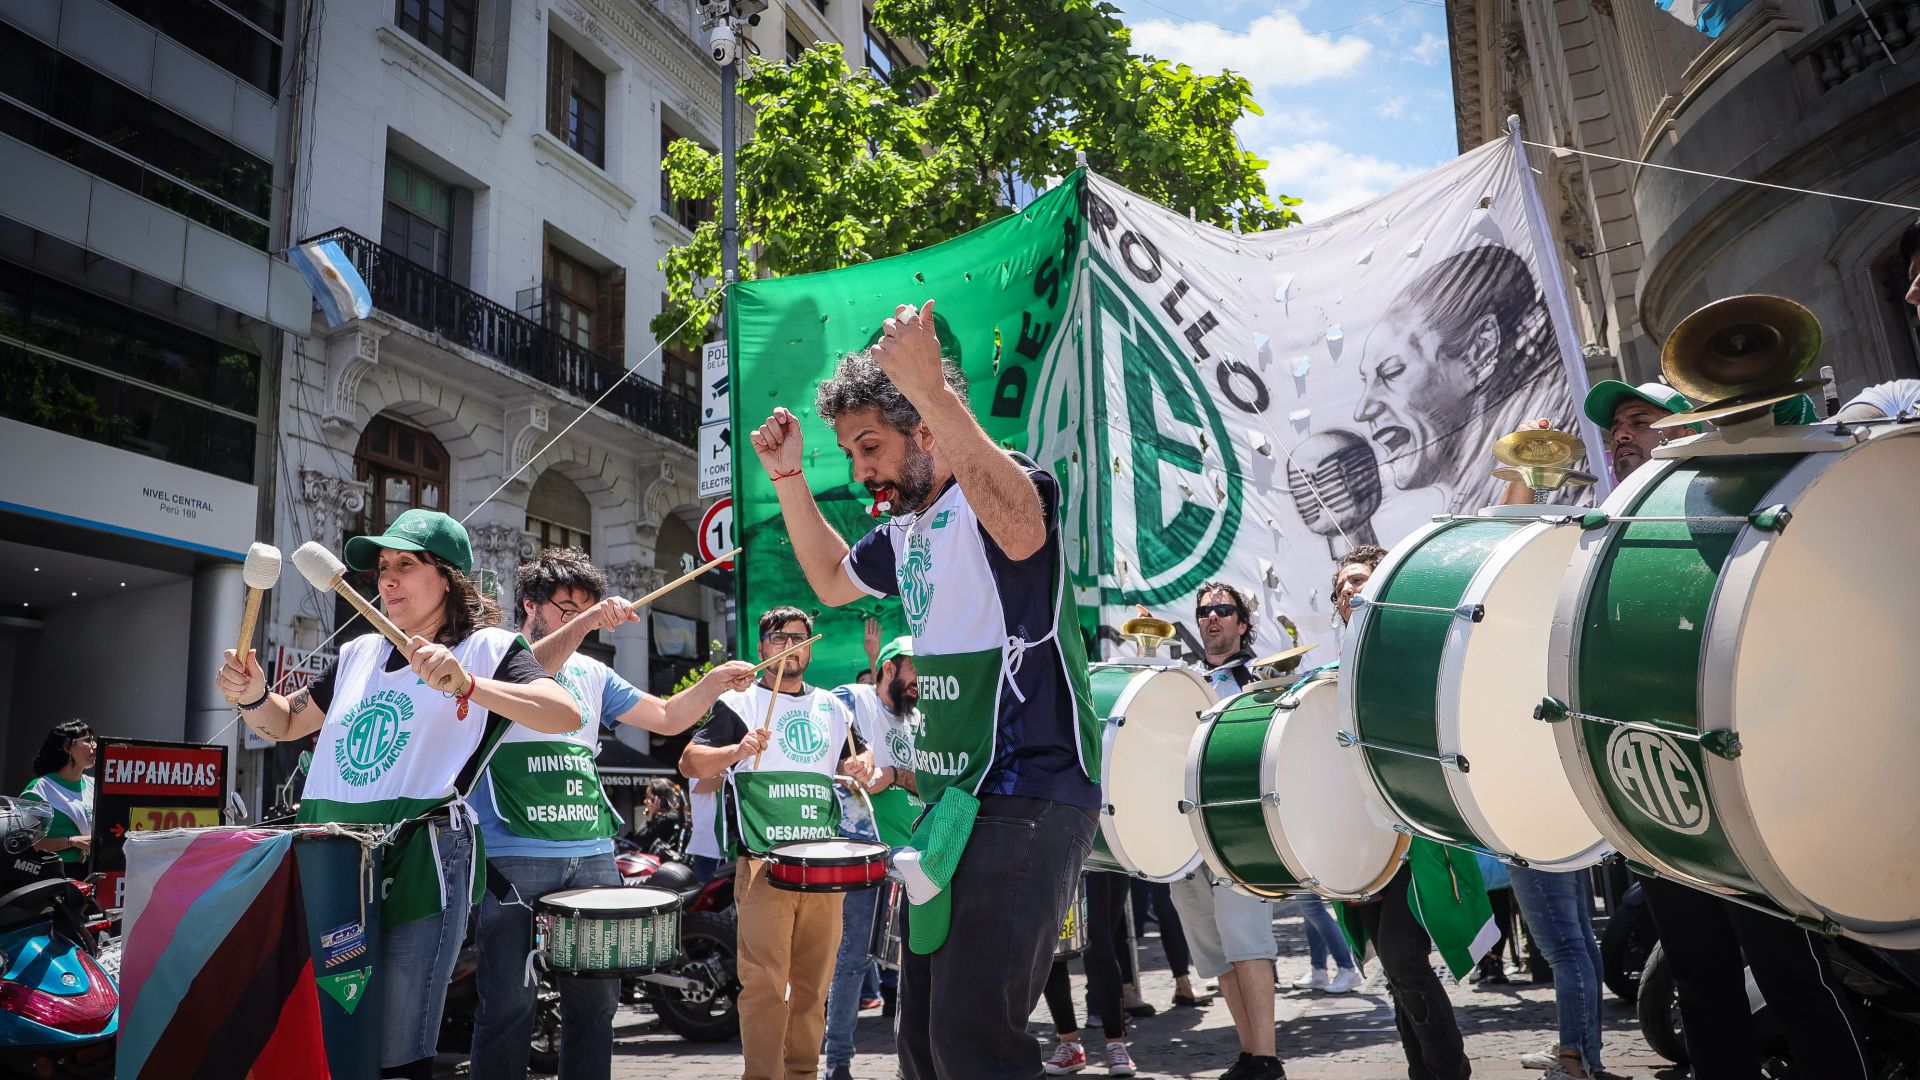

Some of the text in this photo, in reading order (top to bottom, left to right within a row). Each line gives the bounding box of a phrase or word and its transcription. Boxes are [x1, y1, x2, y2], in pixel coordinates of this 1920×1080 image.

[708, 347, 728, 361] POL
[709, 463, 730, 475] CONT
[701, 476, 732, 491] ELECTR
[142, 487, 214, 512] NIVEL CENTRAL
[183, 508, 197, 519] 169
[917, 675, 960, 700] TERIO
[351, 707, 394, 764] ATE
[789, 721, 820, 751] ATE
[370, 766, 382, 783] LA
[382, 731, 412, 772] NACION
[786, 752, 812, 764] LIBERAR
[104, 759, 217, 787] EMPANADAS
[1613, 730, 1702, 826] ATE
[566, 779, 584, 796] DE
[801, 804, 817, 820] DE
[13, 859, 42, 875] MAC
